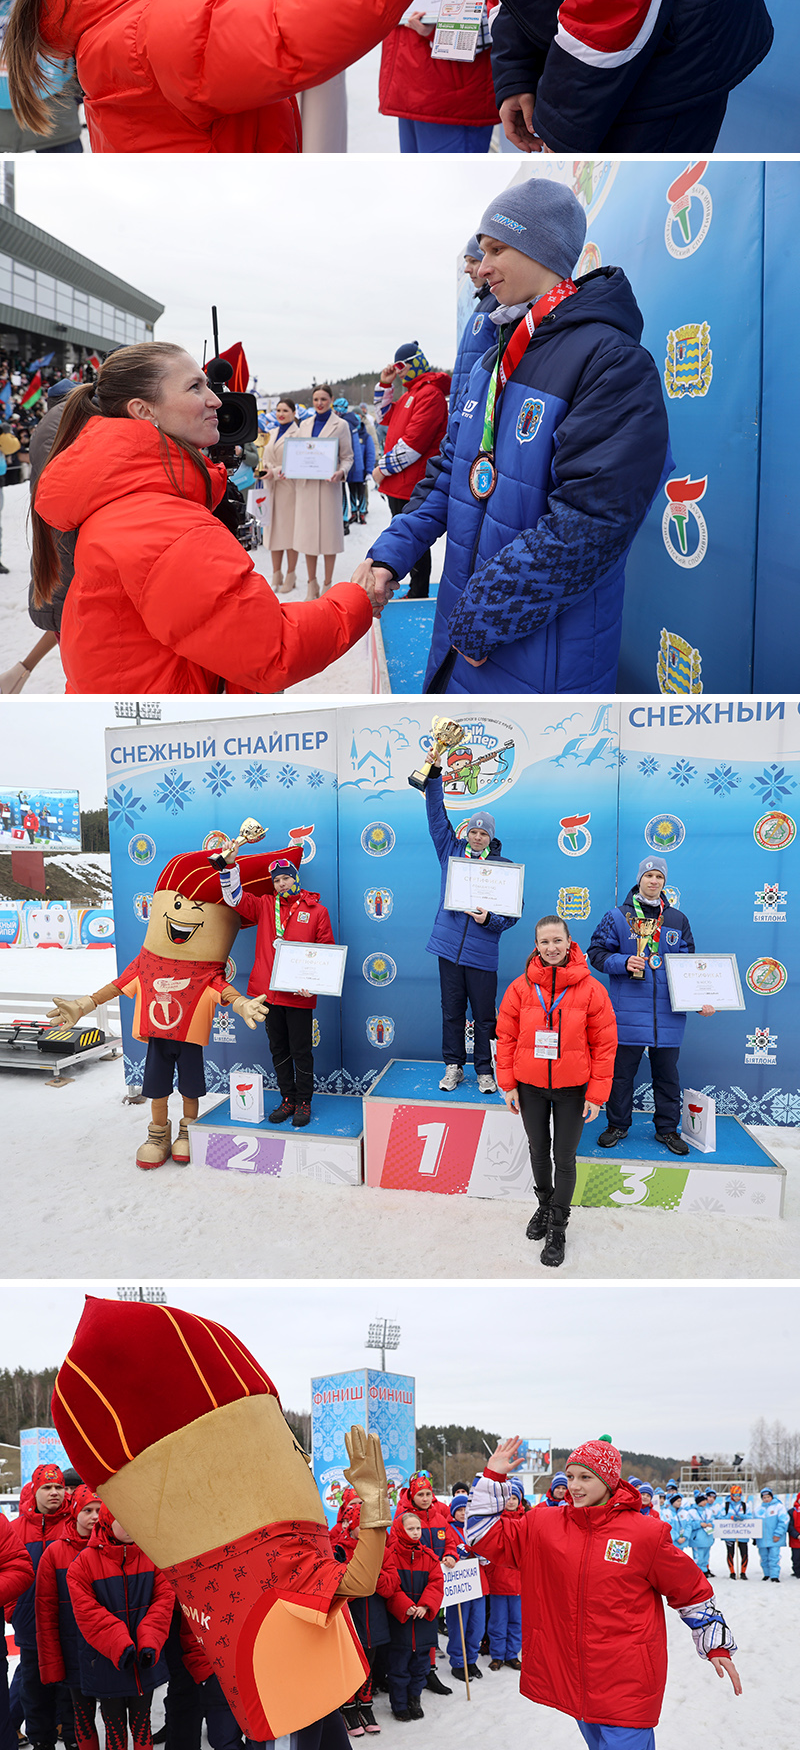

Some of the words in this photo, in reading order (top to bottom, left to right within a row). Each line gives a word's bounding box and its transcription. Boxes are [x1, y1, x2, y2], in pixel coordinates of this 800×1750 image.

[491, 213, 527, 234] MINSK
[110, 736, 216, 764] СНЕЖНЫЙ
[223, 730, 329, 756] СНАЙПЕР
[452, 782, 458, 791] 1
[227, 1135, 261, 1173] 2
[417, 1122, 449, 1178] 1
[609, 1165, 657, 1205] 3
[314, 1385, 363, 1405] ФИНИШ
[369, 1385, 413, 1405] ФИНИШ
[444, 1567, 477, 1583] ОДНЕНСКАЯ
[445, 1582, 472, 1597] ОБЛАСТЬ
